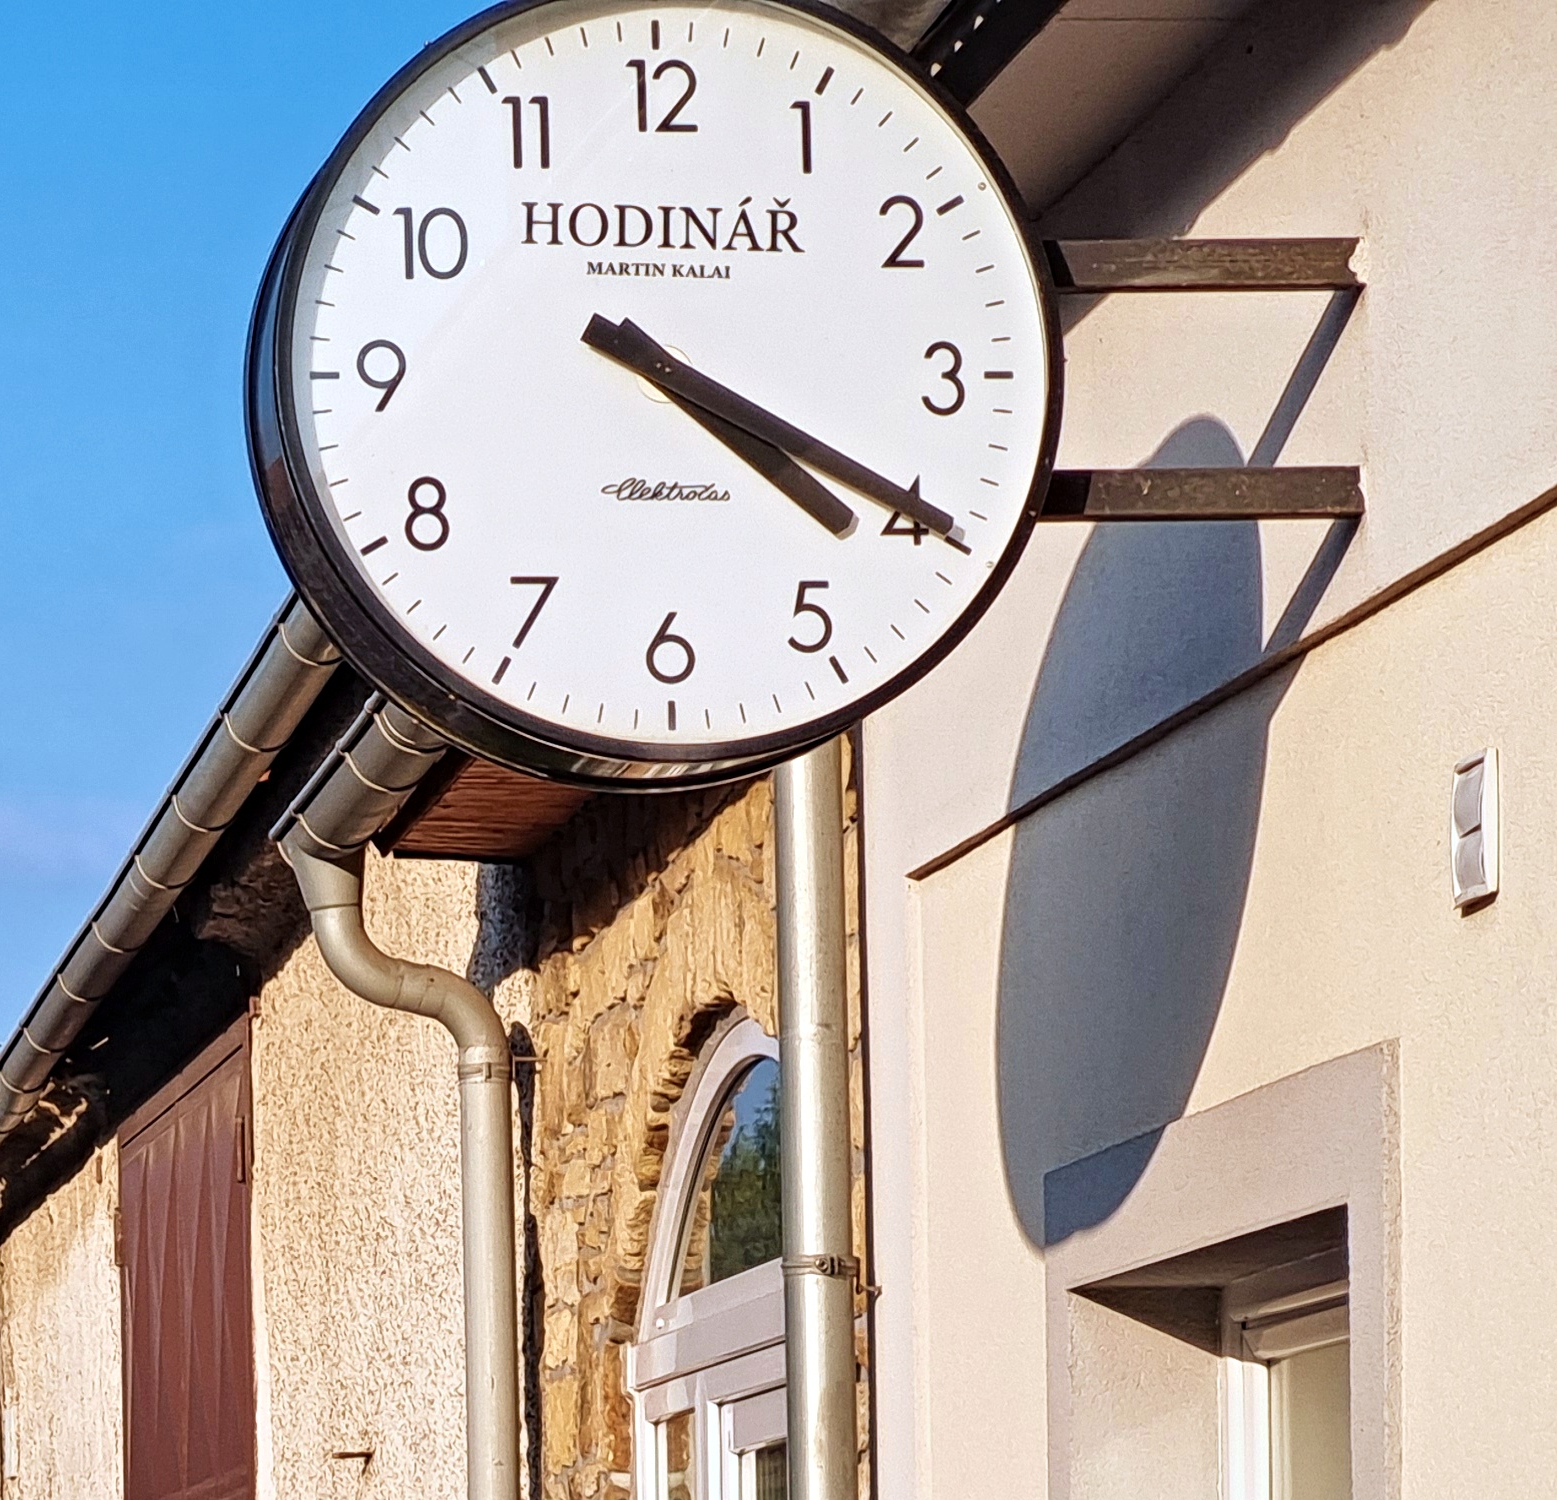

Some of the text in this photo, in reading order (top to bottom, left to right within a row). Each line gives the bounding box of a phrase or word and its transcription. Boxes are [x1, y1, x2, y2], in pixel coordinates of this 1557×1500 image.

[501, 96, 551, 169] 11
[625, 59, 699, 133] 12
[790, 100, 813, 174] 1
[393, 207, 469, 280] 10
[521, 196, 805, 253] HODINÁŘ
[879, 195, 925, 269] 2
[587, 261, 731, 279] MARTIN KALAI
[356, 339, 407, 412] 9
[921, 341, 966, 416] 3
[404, 476, 451, 552] 8
[510, 576, 559, 649] 7
[645, 611, 696, 685] 6
[787, 580, 833, 654] 5
